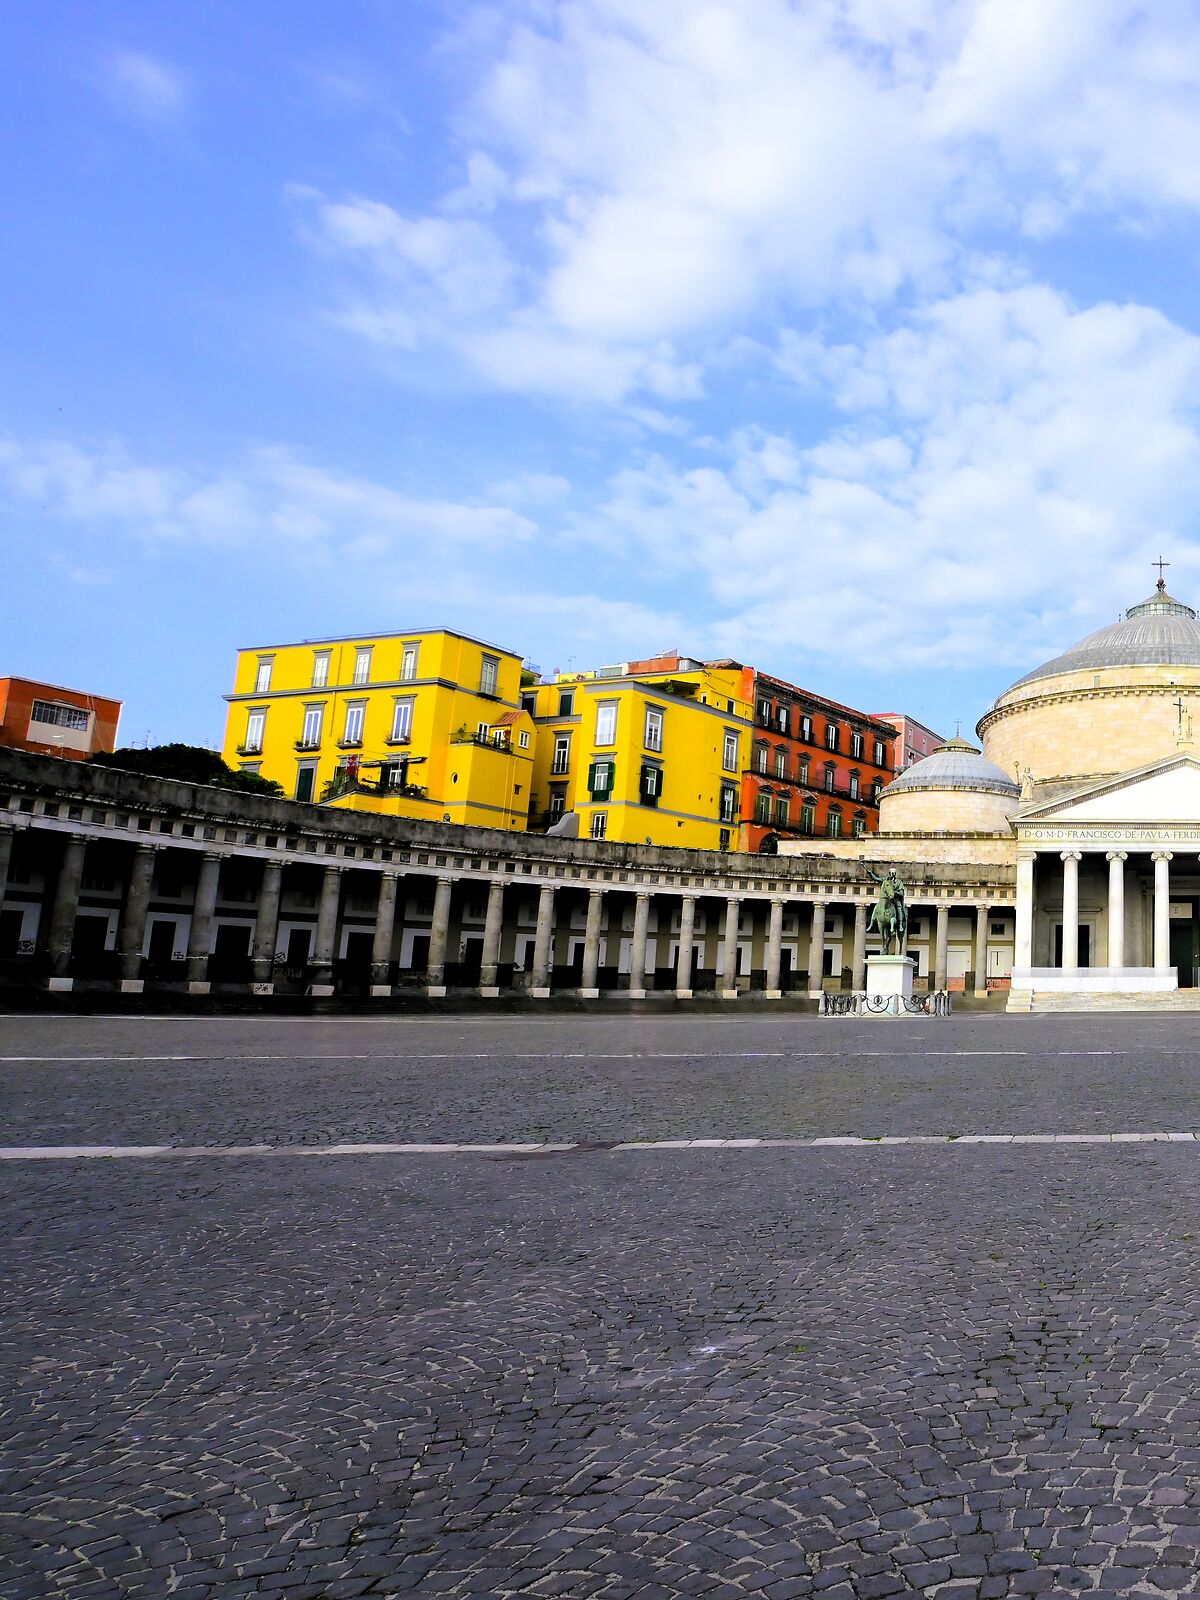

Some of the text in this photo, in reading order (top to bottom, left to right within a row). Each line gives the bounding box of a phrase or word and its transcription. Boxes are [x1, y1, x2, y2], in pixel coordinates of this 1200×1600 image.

[1067, 830, 1122, 839] FRANCISCO
[1125, 830, 1137, 839] DE
[1140, 831, 1170, 839] PAVLA
